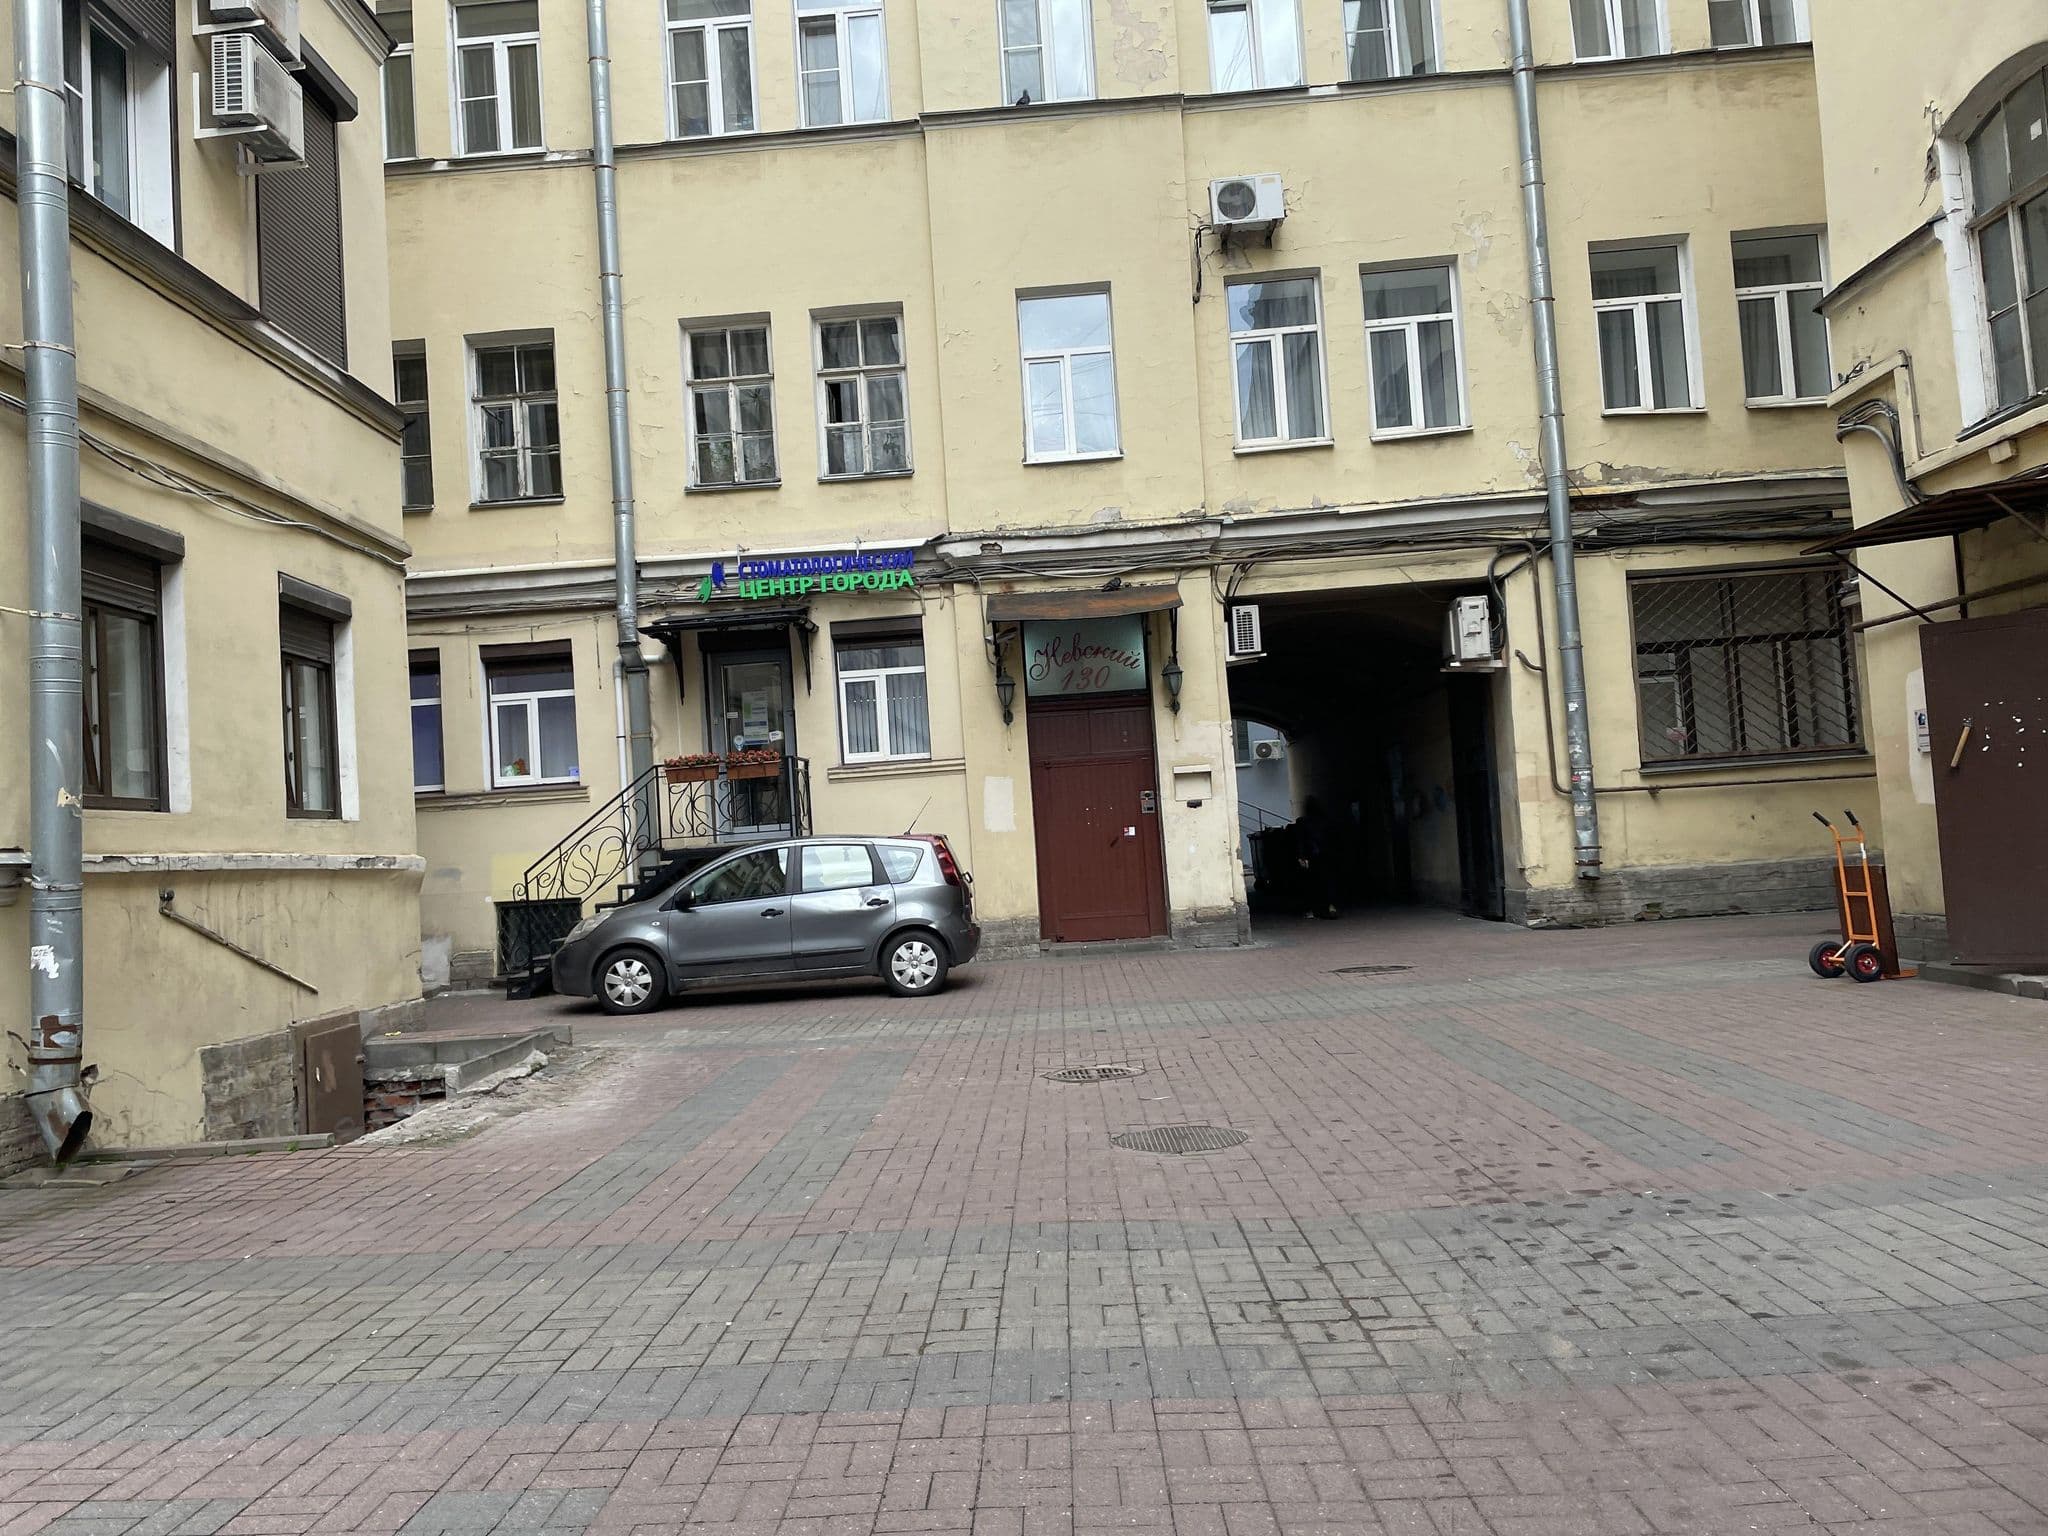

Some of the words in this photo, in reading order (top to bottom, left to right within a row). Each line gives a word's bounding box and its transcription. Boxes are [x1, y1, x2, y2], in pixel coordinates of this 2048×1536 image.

[739, 549, 914, 580] СТОМАТОЛОГИЧЕСКИЙ
[740, 575, 813, 600] ЦЕНТР
[821, 569, 915, 593] ГОРОДА
[1030, 632, 1141, 681] Невский
[1063, 665, 1110, 690] 130
